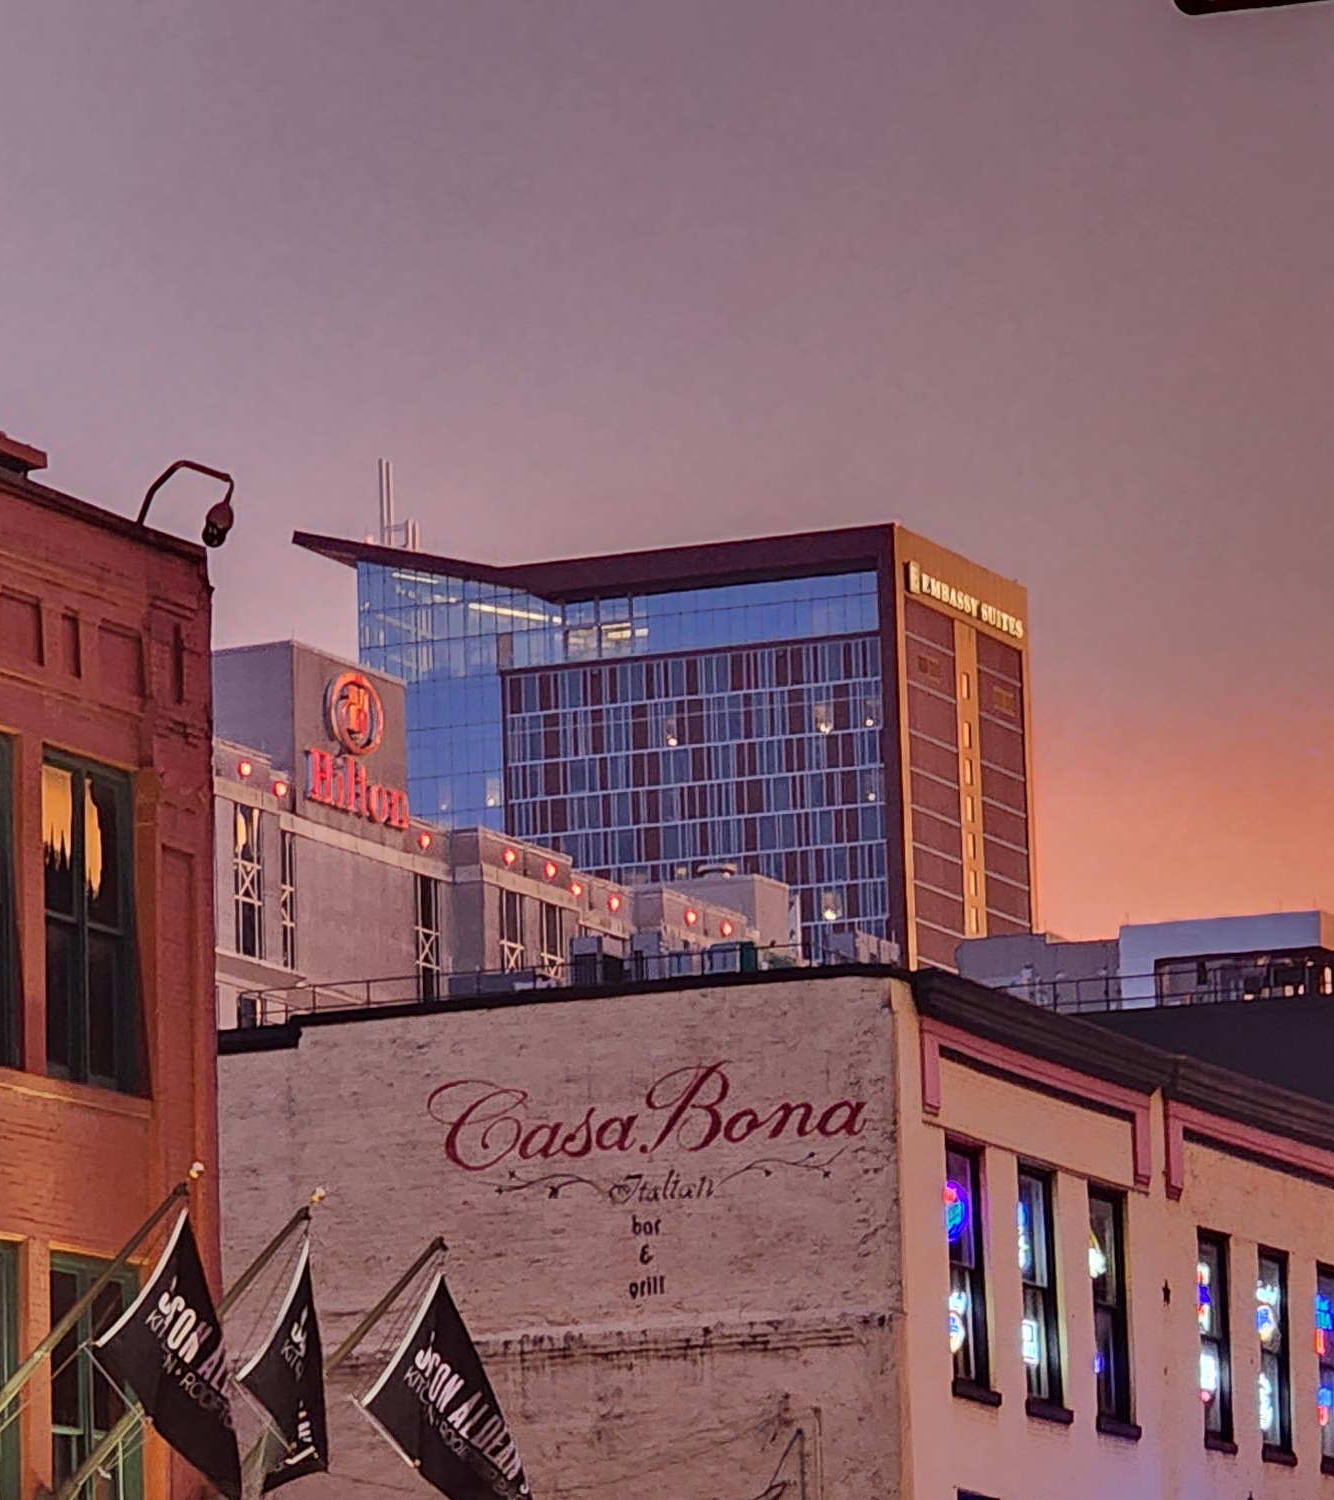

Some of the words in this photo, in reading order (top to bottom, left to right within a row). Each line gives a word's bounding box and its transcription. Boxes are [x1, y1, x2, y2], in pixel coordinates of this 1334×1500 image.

[921, 572, 980, 618] EMBASSY
[980, 602, 1024, 639] SUITES
[310, 747, 410, 830] Hilton
[427, 1079, 638, 1172] Casa
[640, 1059, 867, 1155] Bona
[607, 1169, 716, 1204] Italian
[631, 1215, 662, 1237] bar
[639, 1244, 655, 1266] &
[628, 1275, 667, 1301] grill
